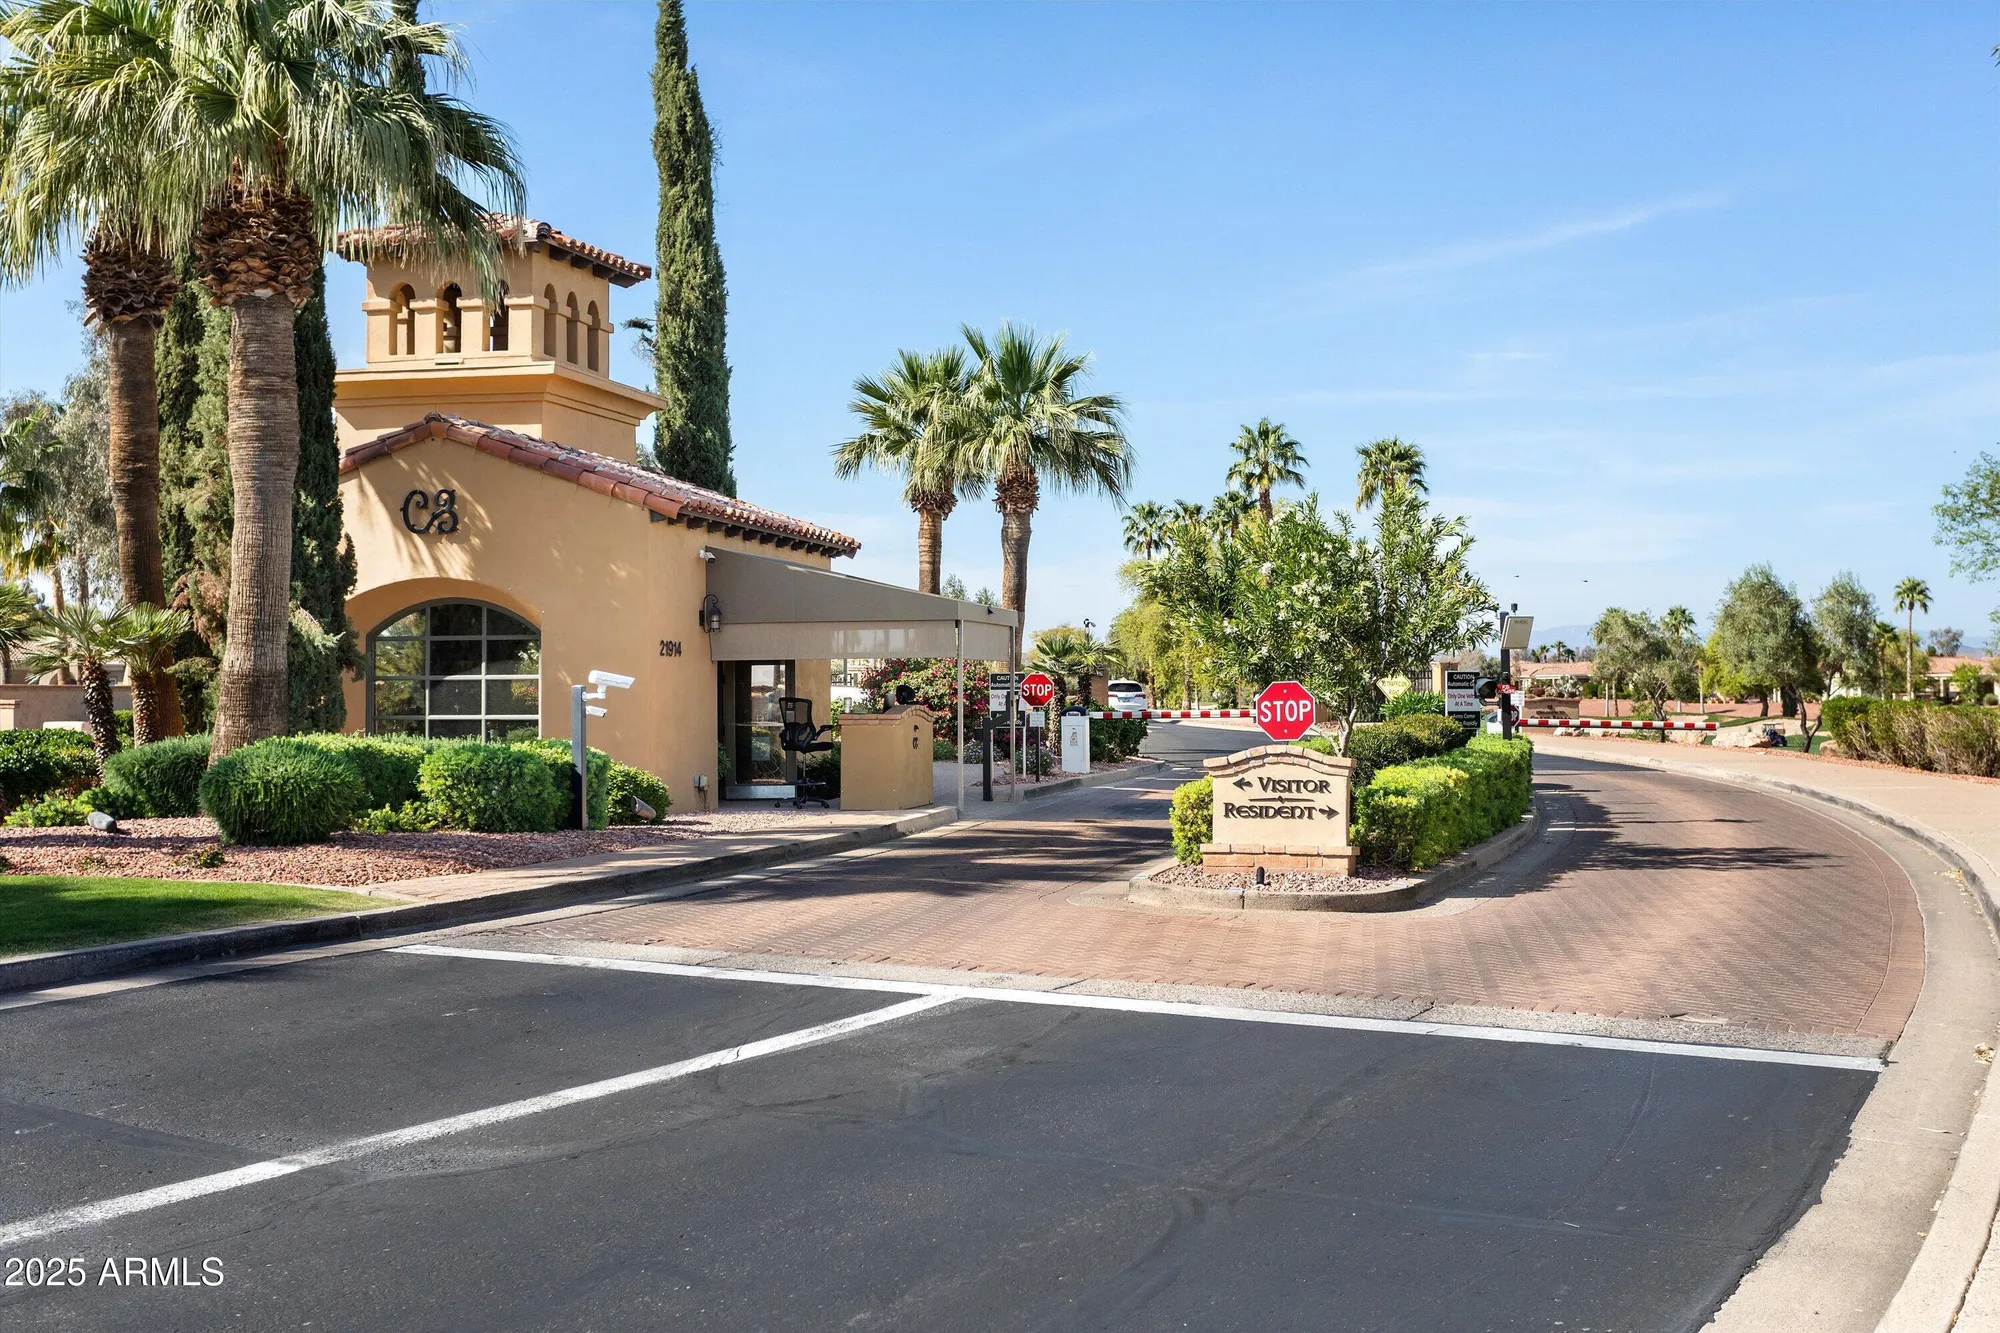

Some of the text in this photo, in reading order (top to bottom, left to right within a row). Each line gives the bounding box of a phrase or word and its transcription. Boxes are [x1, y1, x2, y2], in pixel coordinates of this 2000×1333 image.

[659, 639, 682, 657] 21914
[1022, 684, 1052, 697] STOP
[1260, 700, 1312, 723] STOP
[1257, 776, 1332, 794] VISITOR
[1223, 802, 1318, 820] RESIDENT
